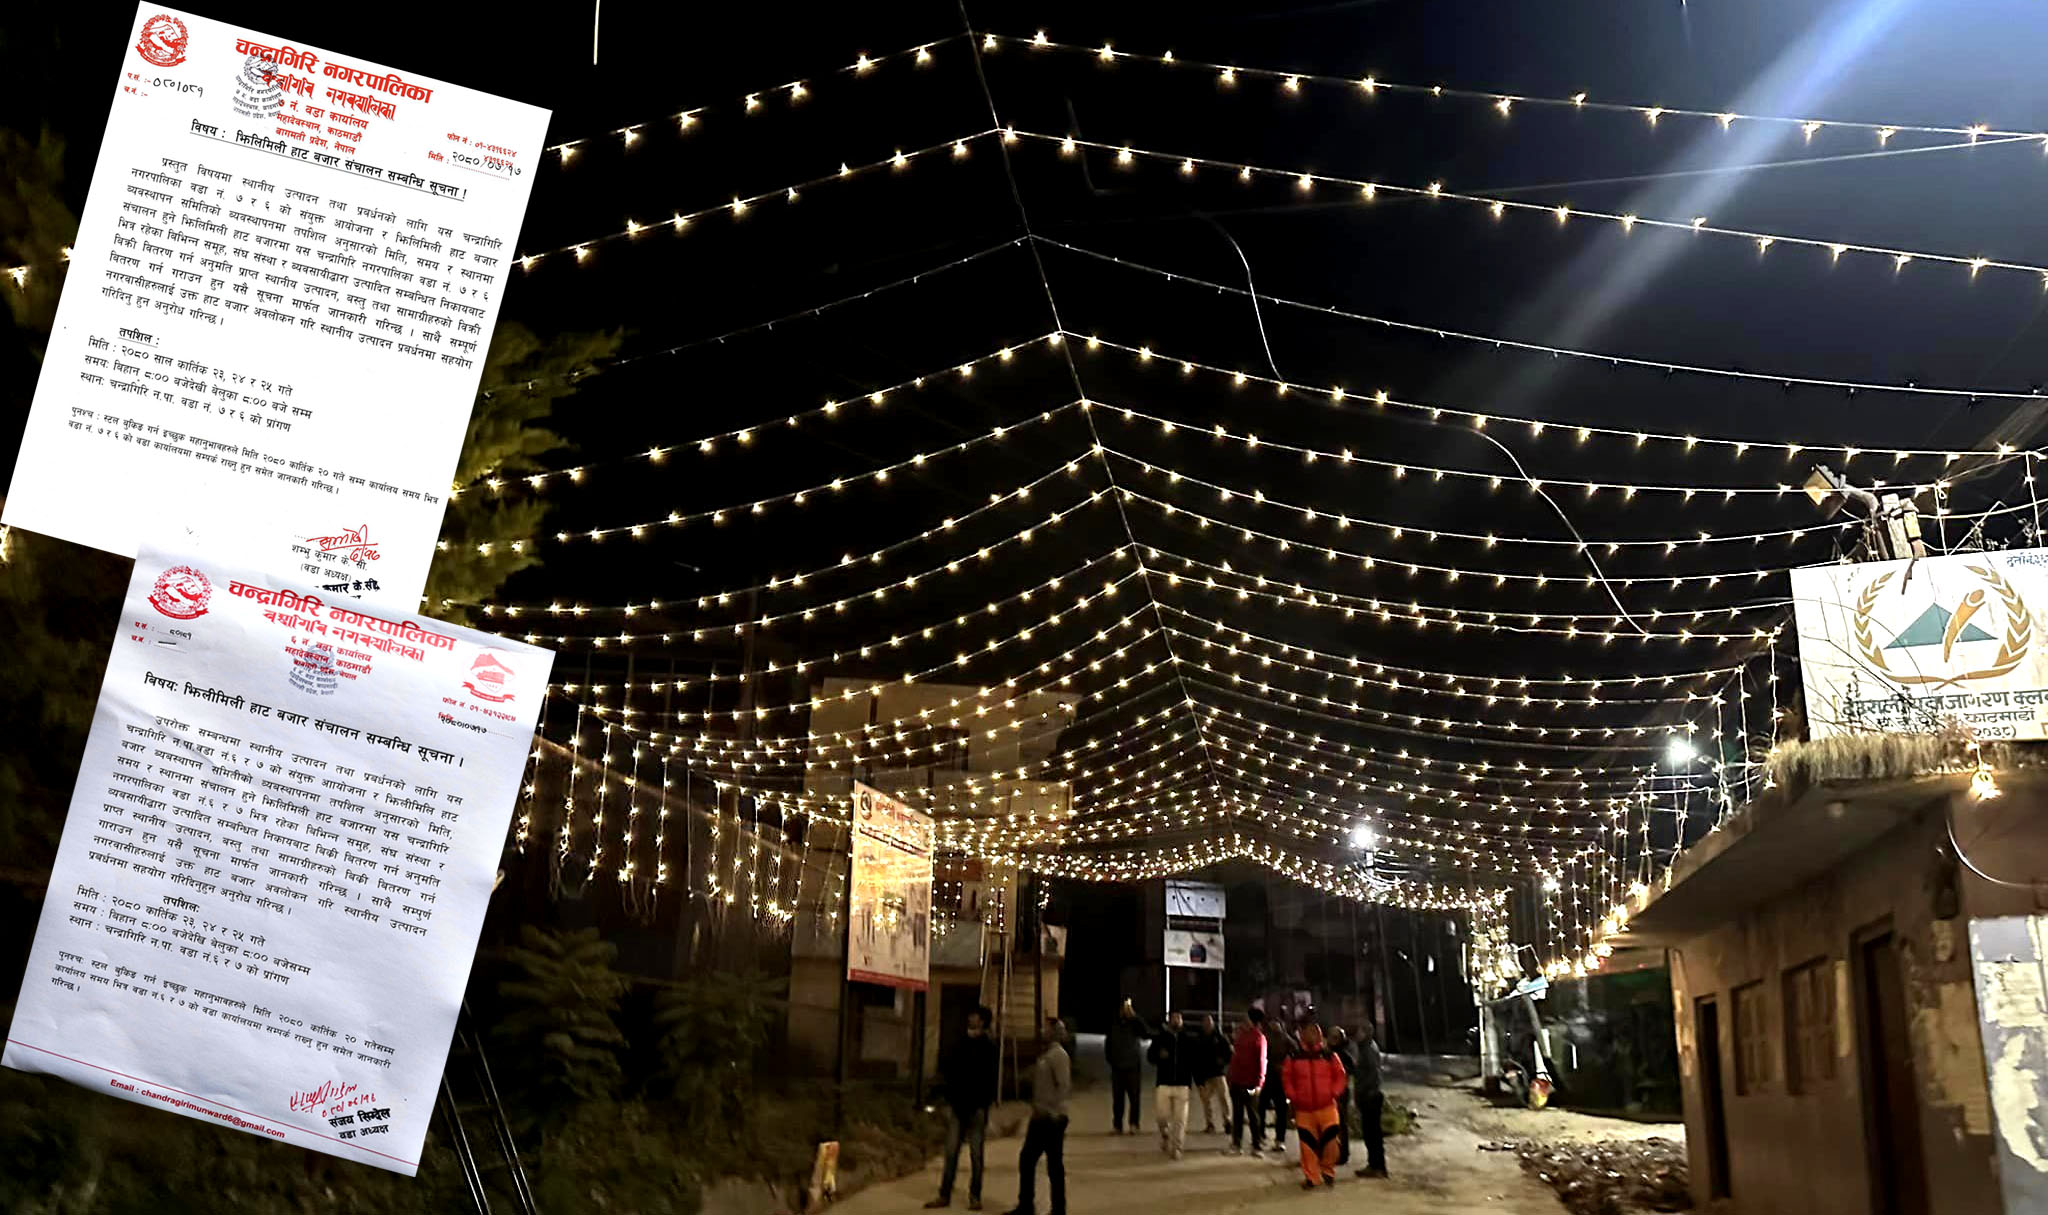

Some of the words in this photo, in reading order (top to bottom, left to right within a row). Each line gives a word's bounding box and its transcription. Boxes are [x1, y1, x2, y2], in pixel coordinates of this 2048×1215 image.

[234, 37, 321, 75] चन्द्रागिरि
[321, 60, 435, 104] नगरपालिका
[328, 110, 370, 131] कार्यालय
[189, 117, 219, 137] विषय
[234, 128, 288, 154] झिलिमिली
[289, 145, 311, 160] हाट
[343, 158, 384, 179] संचालन
[386, 169, 426, 189] सम्बन्धि
[428, 179, 460, 198] सूचना
[332, 139, 357, 156] नेपाल
[118, 326, 154, 344] तपशिल
[87, 333, 110, 351] मिति
[120, 344, 150, 360] २०८०
[152, 353, 174, 367] साल
[176, 358, 209, 375] कार्तिक
[212, 367, 226, 383] २३,
[231, 372, 246, 384] २४
[249, 377, 257, 386] र
[260, 379, 273, 393] २५
[277, 383, 294, 397] गते
[313, 549, 338, 563] कुमार
[227, 579, 326, 618] चन्द्रागिरि
[328, 604, 457, 652] नगरपालिका
[182, 680, 247, 711] झिलीमिली
[248, 701, 273, 718] हाट
[275, 708, 310, 728] बजार
[313, 717, 362, 741] संचालन
[365, 731, 413, 754] सम्बन्धि
[416, 744, 456, 765] सूचना
[110, 1079, 134, 1092] Email
